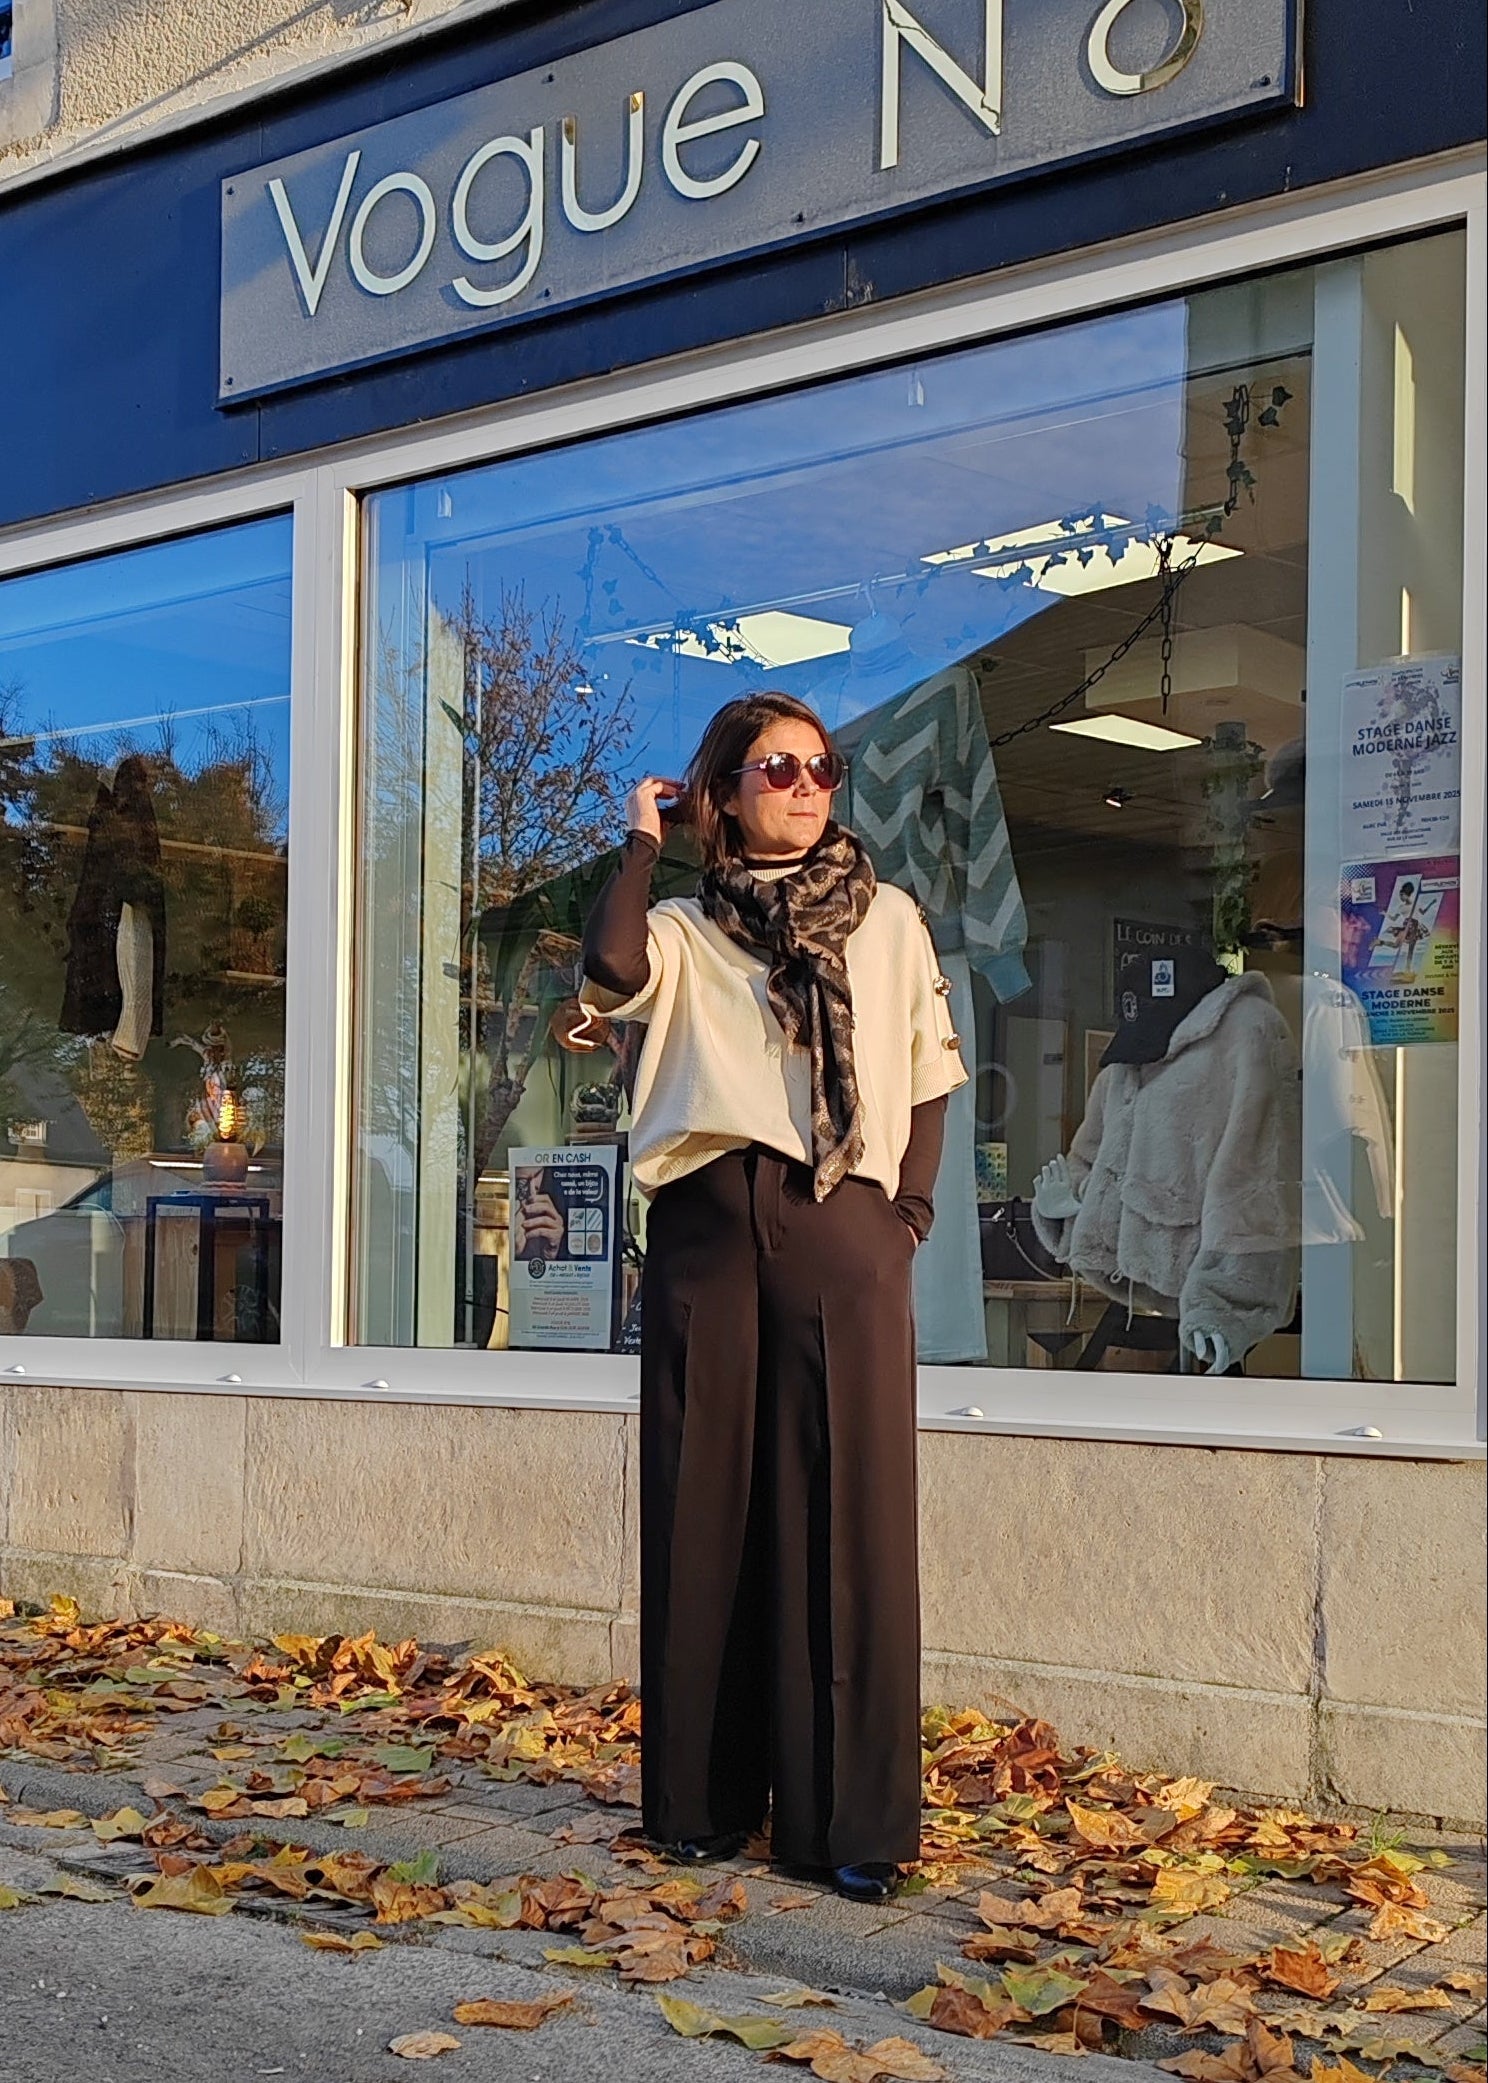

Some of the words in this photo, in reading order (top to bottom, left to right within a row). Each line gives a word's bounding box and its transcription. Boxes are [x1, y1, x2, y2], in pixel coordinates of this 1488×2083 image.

[268, 61, 764, 315] Vogue
[1358, 723, 1401, 740] STAGE
[1406, 717, 1451, 734] DANSE
[1352, 735, 1422, 756] MODERNE
[1425, 731, 1457, 749] JAZZ
[1352, 798, 1383, 809] SAMEDI
[1386, 797, 1393, 805] 15
[1396, 792, 1441, 804] NOVEMBRE
[1136, 928, 1165, 945] COIN
[1361, 990, 1400, 1000] STAGE
[1403, 987, 1445, 996] DANSE
[1371, 999, 1431, 1010] MODERNE
[535, 1154, 549, 1163] OR
[552, 1154, 564, 1163] EN
[566, 1153, 591, 1163] CASH
[548, 1264, 567, 1272] Achat
[574, 1264, 591, 1272] Vente
